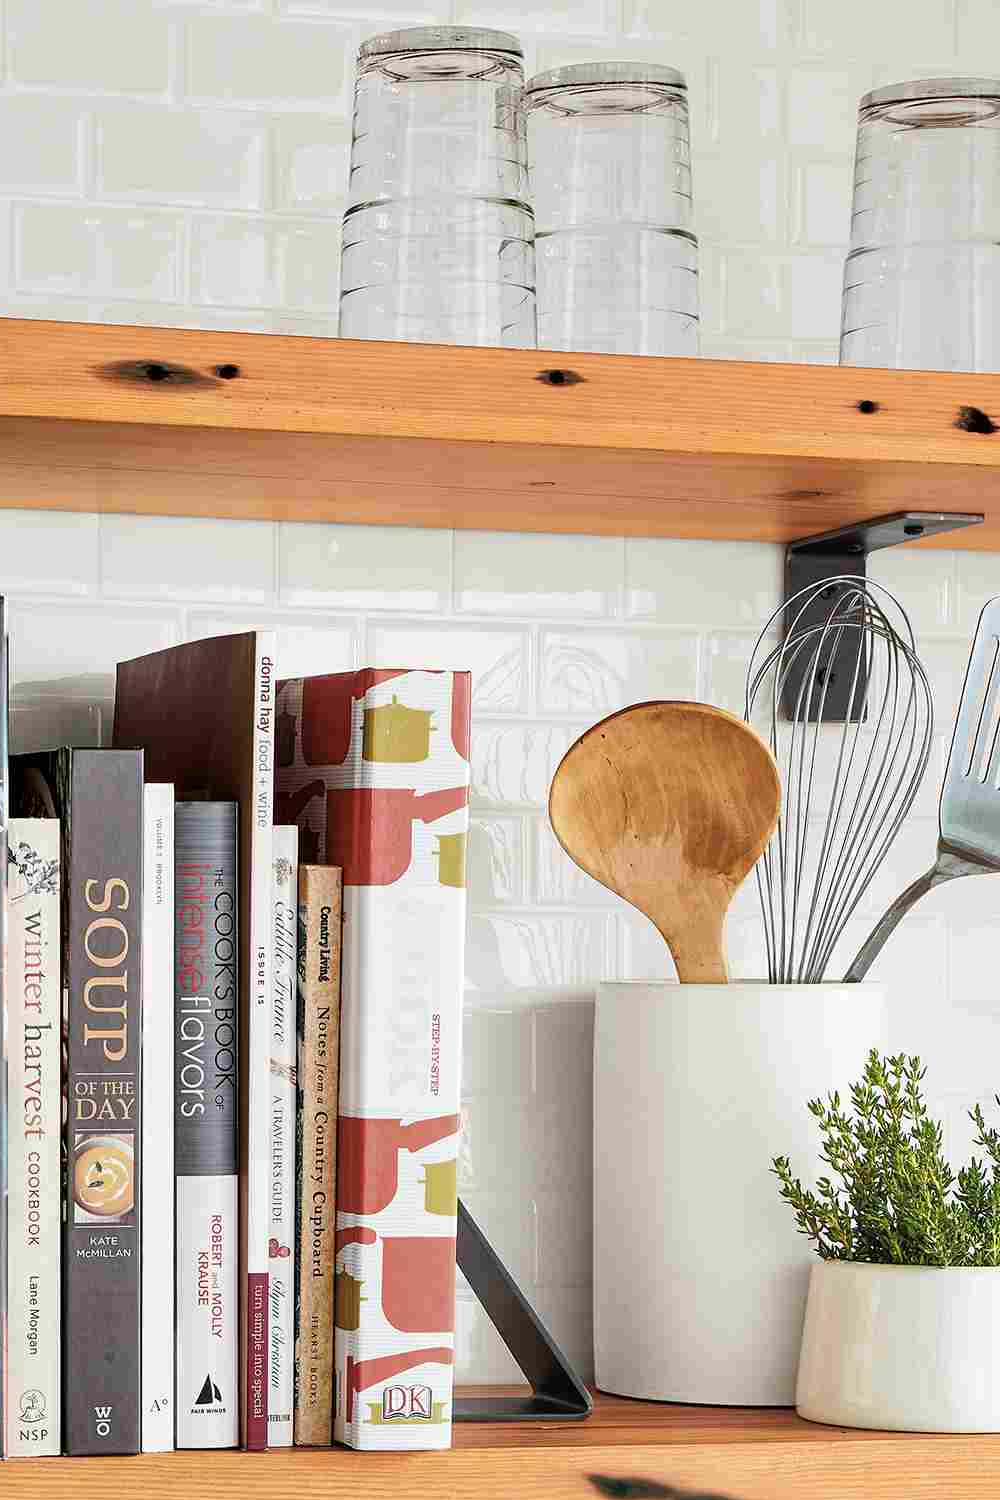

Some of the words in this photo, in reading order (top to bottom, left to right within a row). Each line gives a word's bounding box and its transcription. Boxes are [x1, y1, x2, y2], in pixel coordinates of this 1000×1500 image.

[260, 657, 273, 702] donna
[257, 707, 272, 733] hay
[258, 740, 272, 772] food
[257, 792, 270, 828] wine
[215, 867, 224, 887] THE
[180, 864, 212, 992] intense
[214, 892, 234, 1000] COOK'S
[272, 900, 294, 969] Edible
[318, 906, 331, 948] Country
[24, 911, 49, 1014] winter
[83, 878, 130, 1062] SOUP
[256, 946, 265, 986] ISSUE
[318, 948, 331, 983] Living
[215, 1008, 234, 1088] BOOK
[317, 1006, 331, 1057] Notes
[180, 996, 212, 1117] flavors
[315, 1061, 330, 1092] from
[24, 1023, 52, 1140] harvest
[75, 1081, 100, 1096] OF
[101, 1081, 135, 1096] THE
[272, 1095, 282, 1104] A
[316, 1096, 324, 1104] a
[75, 1098, 136, 1121] DAY
[215, 1095, 225, 1112] OF
[311, 1111, 328, 1184] Country
[28, 1151, 41, 1246] COOKBOOK
[272, 1181, 283, 1224] GUIDE
[76, 1248, 132, 1258] McMILLAN
[89, 1237, 119, 1246] KATE
[211, 1215, 222, 1269] ROBERT
[309, 1191, 326, 1278] Cupboard
[28, 1275, 40, 1306] Lane
[198, 1252, 209, 1306] KRAUSE
[254, 1285, 265, 1310] turn
[26, 1309, 40, 1355] Morgan
[211, 1293, 223, 1338] MOLLY
[252, 1312, 265, 1352] simple
[311, 1315, 321, 1361] HEARST
[254, 1354, 265, 1378] into
[251, 1379, 265, 1419] special
[310, 1367, 320, 1407] BOOKS
[387, 1387, 425, 1414] DK
[94, 1406, 113, 1418] W
[19, 1429, 49, 1441] NSP
